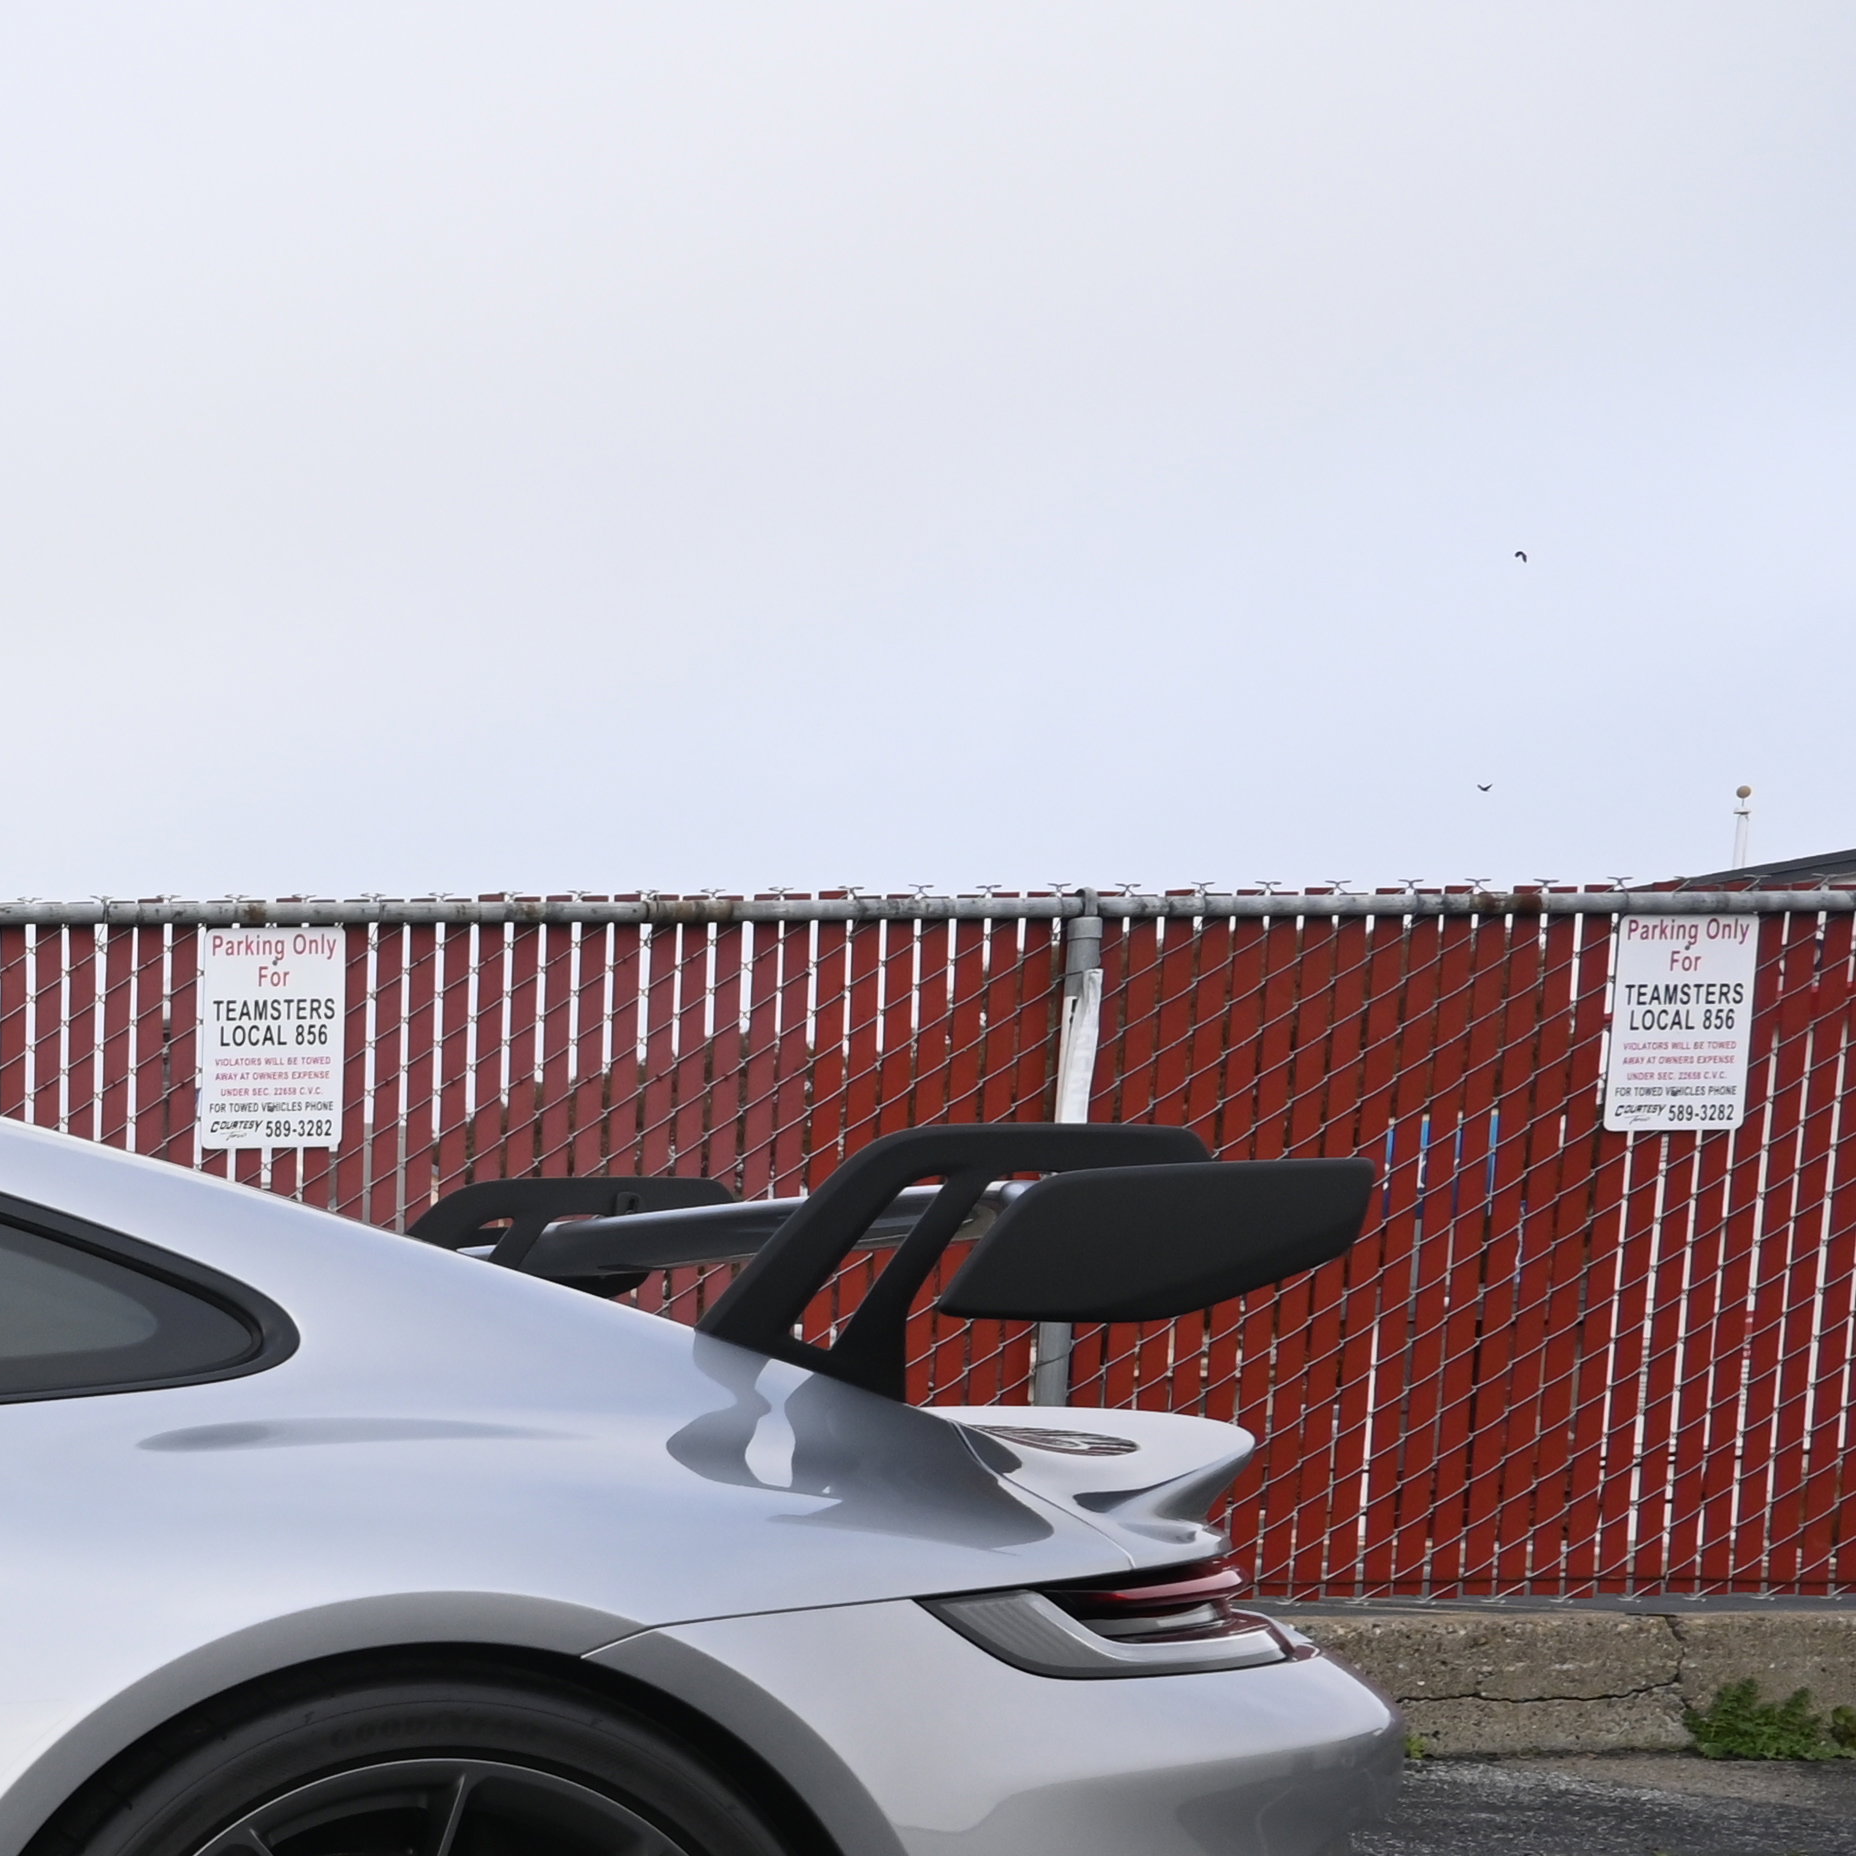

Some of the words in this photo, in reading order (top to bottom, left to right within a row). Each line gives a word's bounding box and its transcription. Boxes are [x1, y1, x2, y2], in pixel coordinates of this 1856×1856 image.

[1627, 919, 1699, 945] Parking
[1706, 918, 1751, 945] Only
[212, 934, 285, 961] Parking
[292, 933, 337, 960] Only
[1669, 951, 1702, 972] For
[258, 966, 290, 987] For
[1624, 983, 1745, 1006] TEAMSTERS
[213, 998, 336, 1022] TEAMSTERS
[1629, 1009, 1696, 1031] LOCAL
[1702, 1008, 1735, 1030] 856
[219, 1024, 287, 1047] LOCAL
[295, 1024, 328, 1046] 856
[1623, 1041, 1669, 1050] VIOLATORS
[1671, 1041, 1691, 1050] WILL
[1693, 1041, 1705, 1050] BE
[1707, 1040, 1737, 1050] TOWED
[214, 1057, 262, 1067] VIOLATORS
[264, 1057, 284, 1066] WILL
[287, 1056, 299, 1065] BE
[301, 1056, 331, 1065] TOWED
[1622, 1056, 1645, 1065] AWAY
[1646, 1056, 1657, 1064] AT
[1658, 1055, 1694, 1064] OWNERS
[1696, 1055, 1735, 1064] EXPENSE
[215, 1072, 238, 1081] AWAY
[239, 1072, 250, 1080] AT
[252, 1071, 289, 1080] OWNERS
[291, 1070, 331, 1080] EXPENSE
[1626, 1072, 1655, 1081] UNDER
[1703, 1071, 1728, 1080] C.V.C.
[220, 1088, 250, 1097] UNDER
[299, 1086, 323, 1095] C.V.C.
[1614, 1087, 1632, 1097] FOR
[1634, 1086, 1663, 1097] TOWED
[1665, 1086, 1706, 1097] VEHICLES
[1708, 1085, 1737, 1096] PHONE
[209, 1103, 227, 1113] FOR
[229, 1102, 259, 1113] TOWED
[261, 1101, 302, 1112] VEHICLES
[305, 1101, 334, 1111] PHONE
[1614, 1104, 1666, 1117] COURTESY
[1667, 1103, 1735, 1122] 589-3282
[210, 1119, 264, 1133] COURTESY
[265, 1119, 333, 1137] 589-3282
